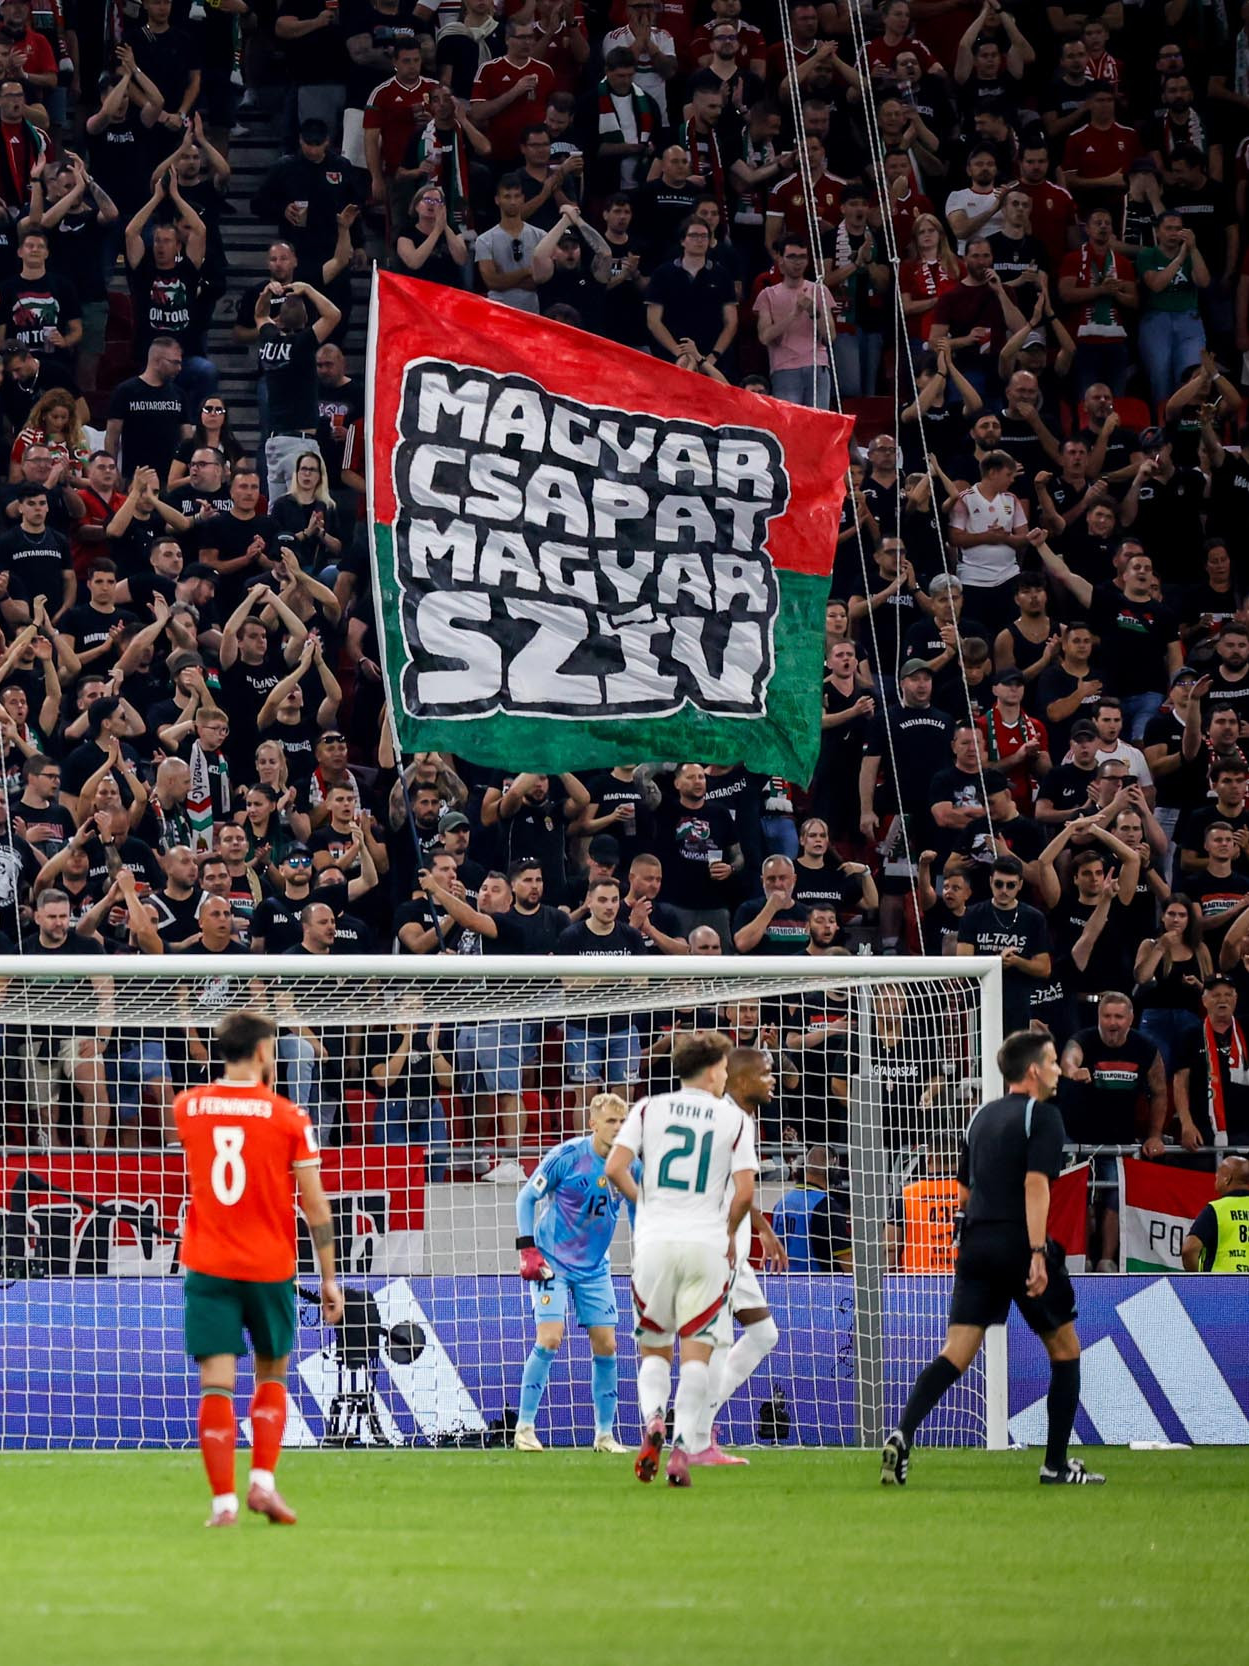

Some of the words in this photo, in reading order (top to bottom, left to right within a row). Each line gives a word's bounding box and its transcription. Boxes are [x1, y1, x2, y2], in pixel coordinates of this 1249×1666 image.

[149, 307, 163, 321] ON
[164, 308, 190, 323] TOUR
[129, 400, 181, 412] MAGYARORSZÁG
[418, 371, 774, 499] MAGYAR
[408, 443, 771, 552] CSAPAT
[408, 519, 768, 613] MAGYAR
[416, 589, 762, 705] SZÍV
[333, 928, 358, 940] ORSZÁG
[976, 932, 1027, 947] ULTRAS
[868, 1062, 919, 1077] AGYARORSZÁG
[211, 1125, 247, 1207] 8
[658, 1124, 714, 1195] 21
[587, 1194, 608, 1217] 12
